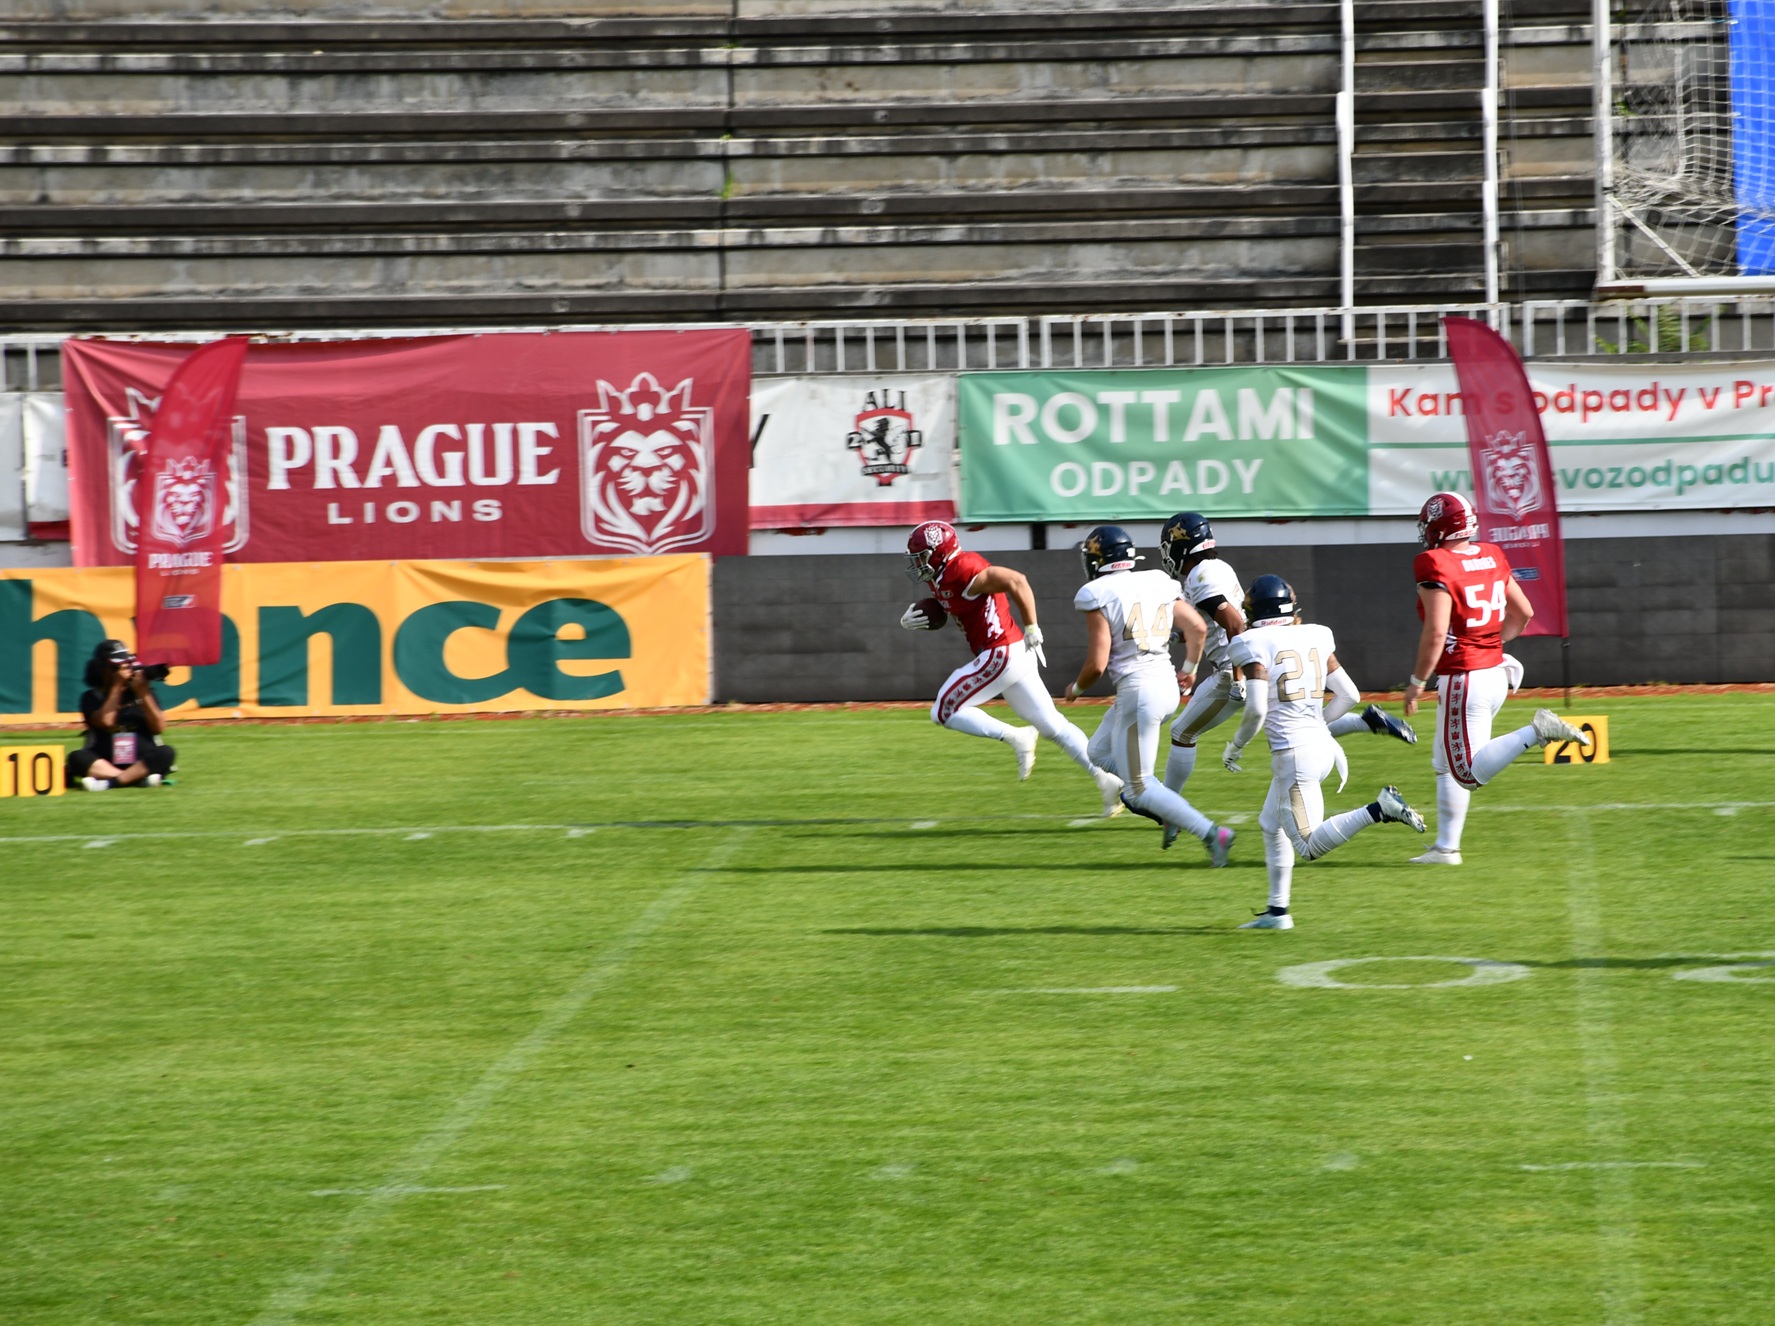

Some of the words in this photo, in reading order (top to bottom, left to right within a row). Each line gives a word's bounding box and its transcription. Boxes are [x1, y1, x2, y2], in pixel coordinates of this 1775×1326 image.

[863, 388, 906, 412] ALI
[1698, 386, 1722, 409] v
[1732, 380, 1775, 410] Pr
[992, 387, 1315, 446] ROTTAMI
[265, 422, 561, 490] PRAGUE
[1050, 458, 1264, 498] ODPADY
[327, 499, 503, 525] LIONS
[148, 552, 213, 569] PRAGUE
[1464, 580, 1507, 628] 54
[1123, 602, 1173, 651] 44
[1274, 648, 1325, 702] 21
[1553, 723, 1597, 764] 20
[9, 752, 53, 796] 10
